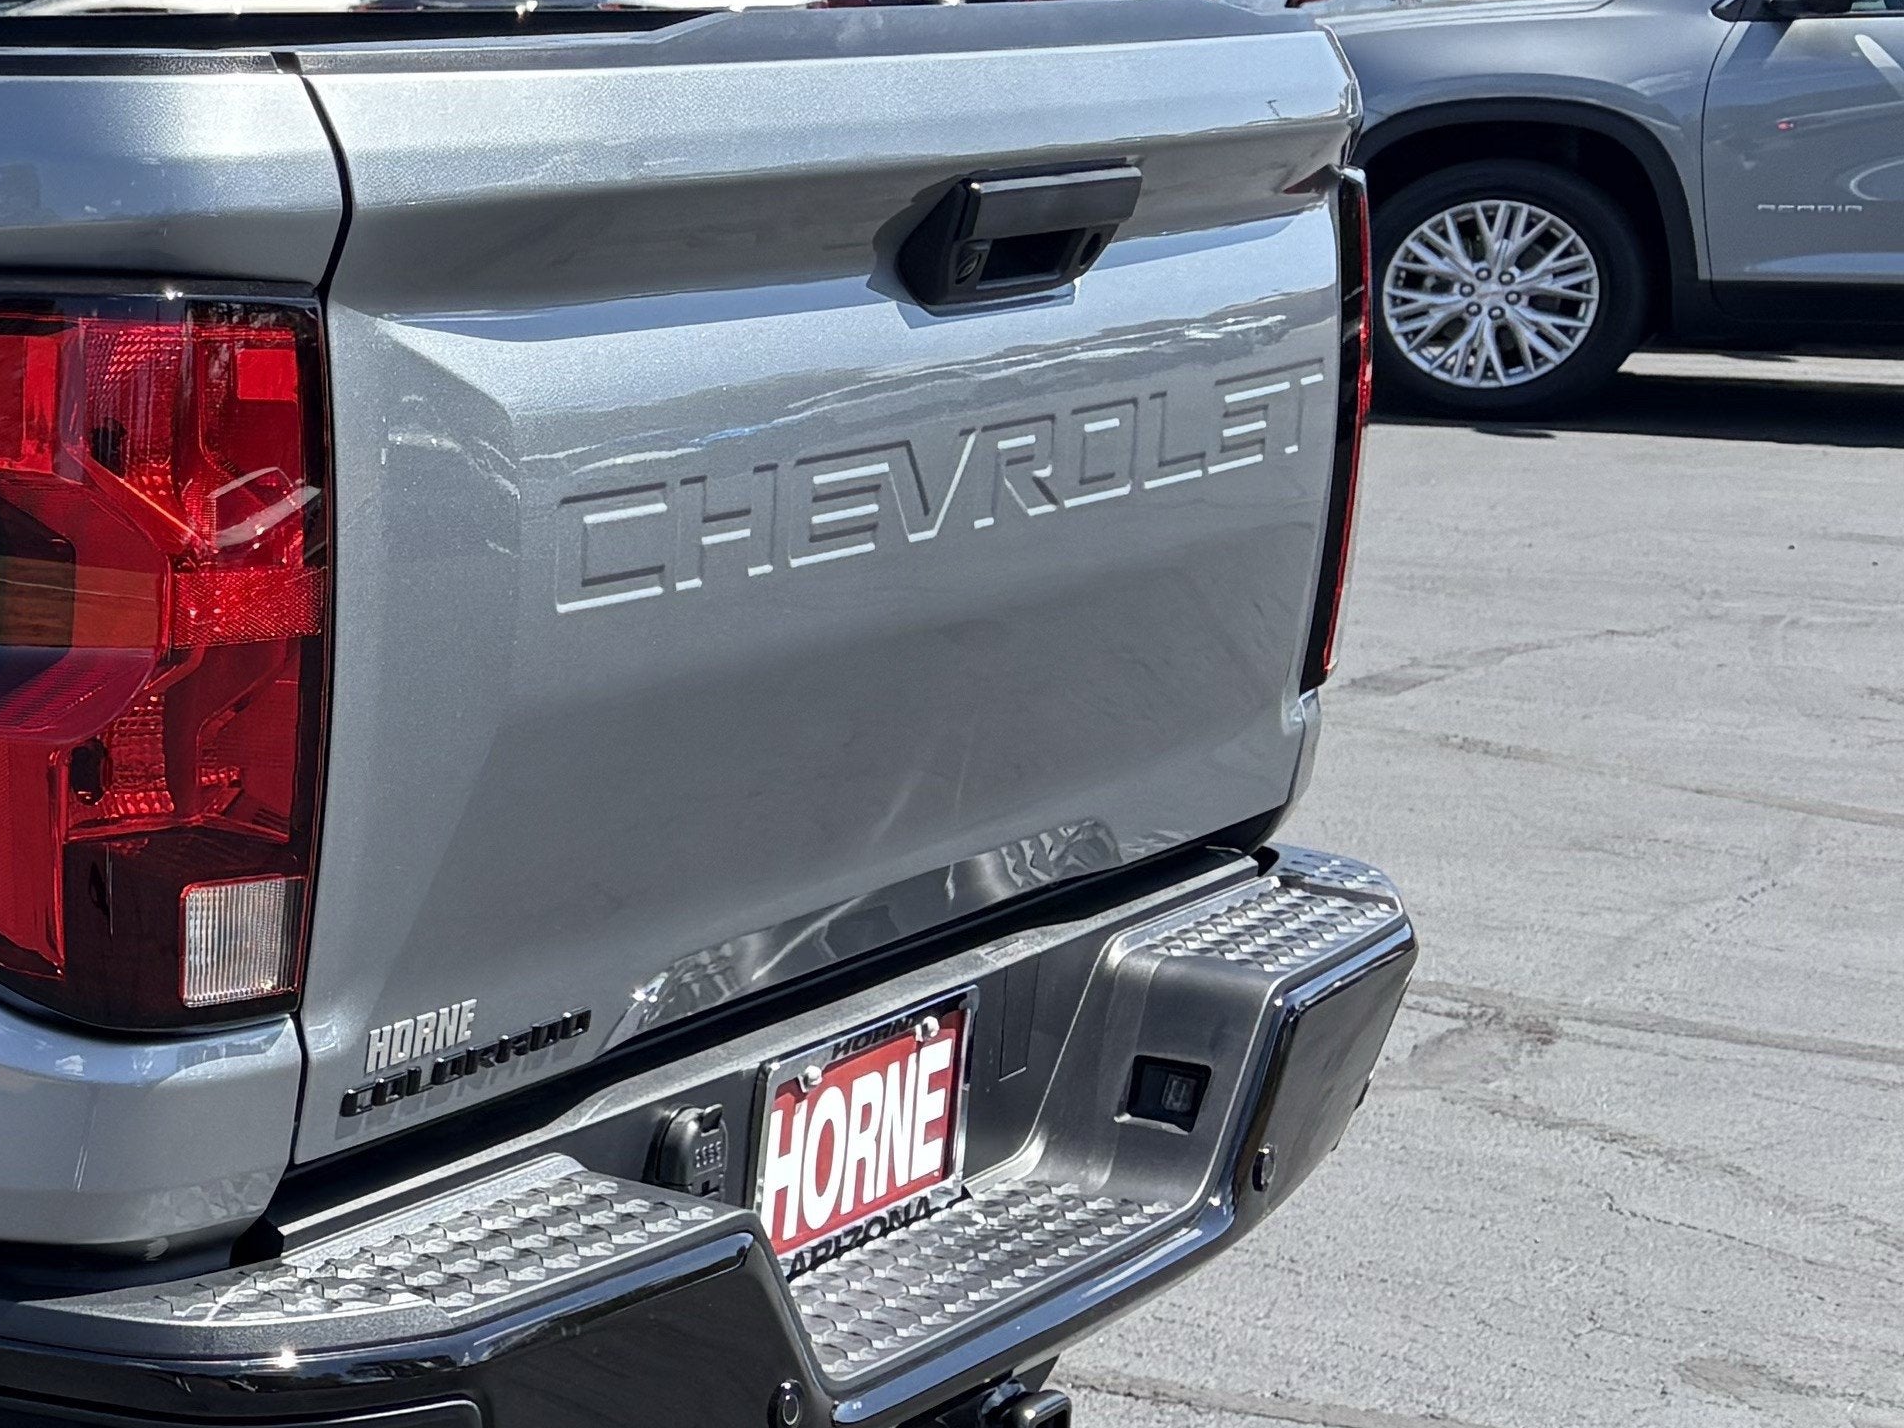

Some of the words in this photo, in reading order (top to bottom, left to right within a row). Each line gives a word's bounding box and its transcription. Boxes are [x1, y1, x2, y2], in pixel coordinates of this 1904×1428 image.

[556, 358, 1326, 613] CHEVROLET
[338, 1006, 592, 1117] COLORADO
[366, 998, 478, 1074] HORNE
[832, 1017, 916, 1060] HORN
[760, 1038, 953, 1242] HORNE
[790, 1195, 931, 1274] ARIZONA
